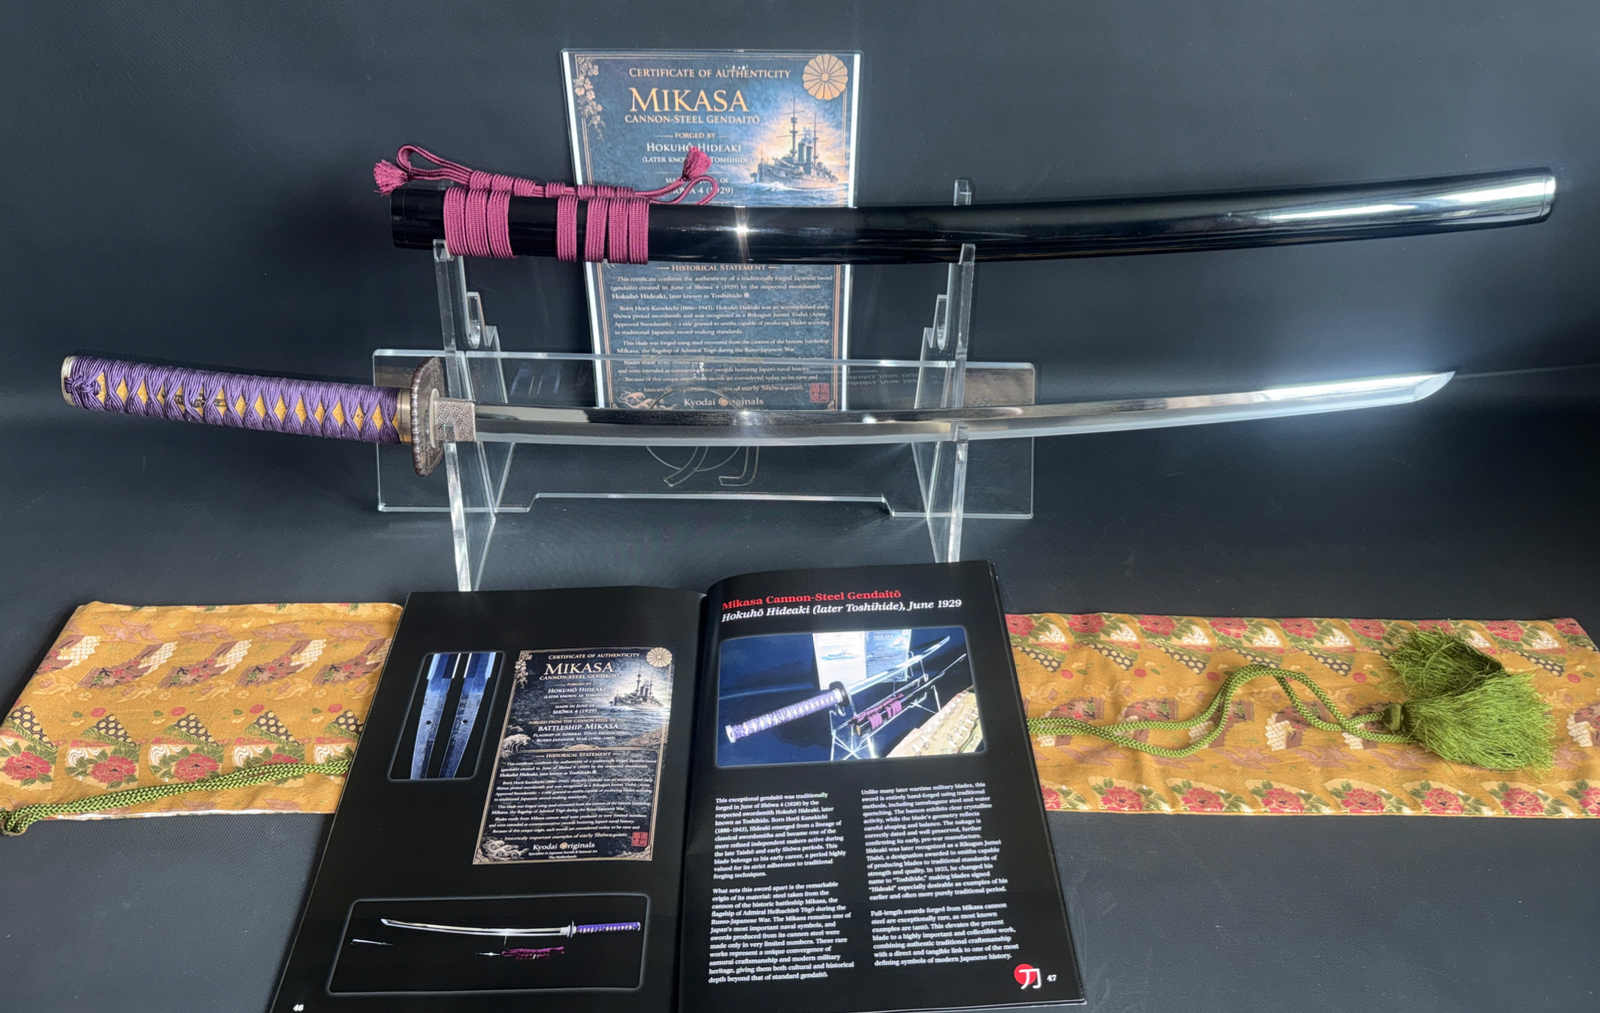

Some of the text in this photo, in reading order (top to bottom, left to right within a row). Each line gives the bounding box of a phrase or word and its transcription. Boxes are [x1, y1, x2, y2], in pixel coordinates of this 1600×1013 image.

[629, 67, 791, 79] CERTIFICATE OF AUTHENTICITY
[629, 87, 749, 113] MIKASA
[625, 115, 703, 124] CANNON-STEEL
[699, 143, 742, 152] HIDEAKI
[642, 156, 666, 164] (LATER
[684, 398, 716, 407] Kyodai
[723, 598, 763, 610] Mikasa
[766, 593, 845, 604] Cannon-Steel
[766, 607, 811, 617] Hideaki
[812, 606, 844, 615] (later
[846, 602, 906, 613] Toshihide),
[906, 601, 935, 612] June
[937, 599, 962, 609] 1929
[544, 662, 614, 675] MIKASA
[538, 724, 583, 732] BATTLESHIP
[533, 843, 558, 851] Kyodai
[870, 909, 903, 917] Full-length
[926, 906, 946, 914] forged
[897, 915, 937, 924] exceptionally
[872, 926, 901, 934] examples
[981, 919, 1004, 928] present
[902, 932, 922, 941] highly
[922, 931, 953, 940] important
[966, 928, 998, 936] collectible
[873, 935, 1012, 950] combining authentic traditional craftsmanship
[925, 948, 951, 956] tangible
[874, 959, 901, 967] defining
[900, 957, 927, 966] symbols
[960, 955, 988, 963] Japanese
[1047, 974, 1057, 982] 47
